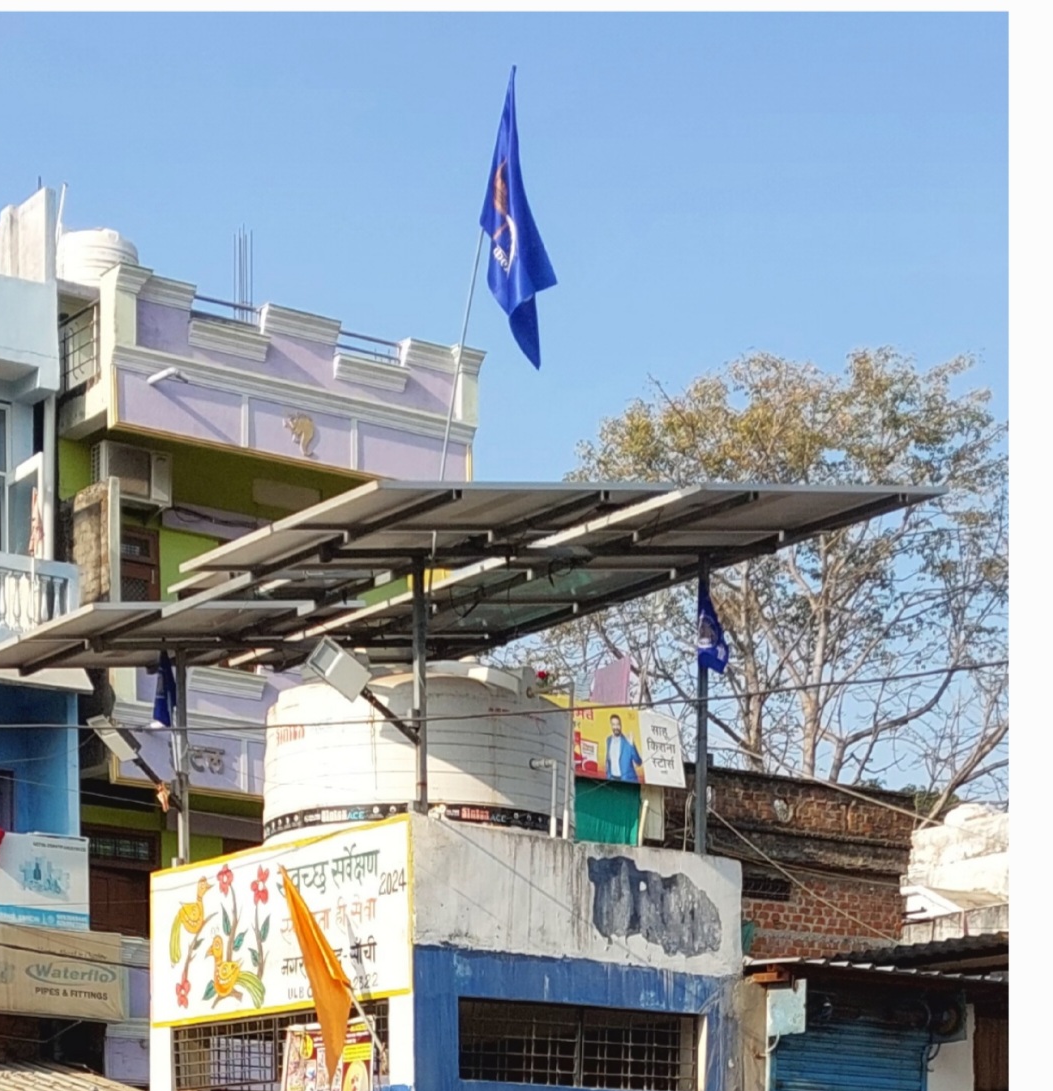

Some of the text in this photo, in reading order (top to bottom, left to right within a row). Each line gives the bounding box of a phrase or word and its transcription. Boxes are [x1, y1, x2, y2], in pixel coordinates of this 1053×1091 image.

[378, 867, 407, 897] 2024
[35, 962, 109, 983] Waterflo
[35, 986, 60, 997] PIPES
[70, 989, 108, 1001] FITTINGS
